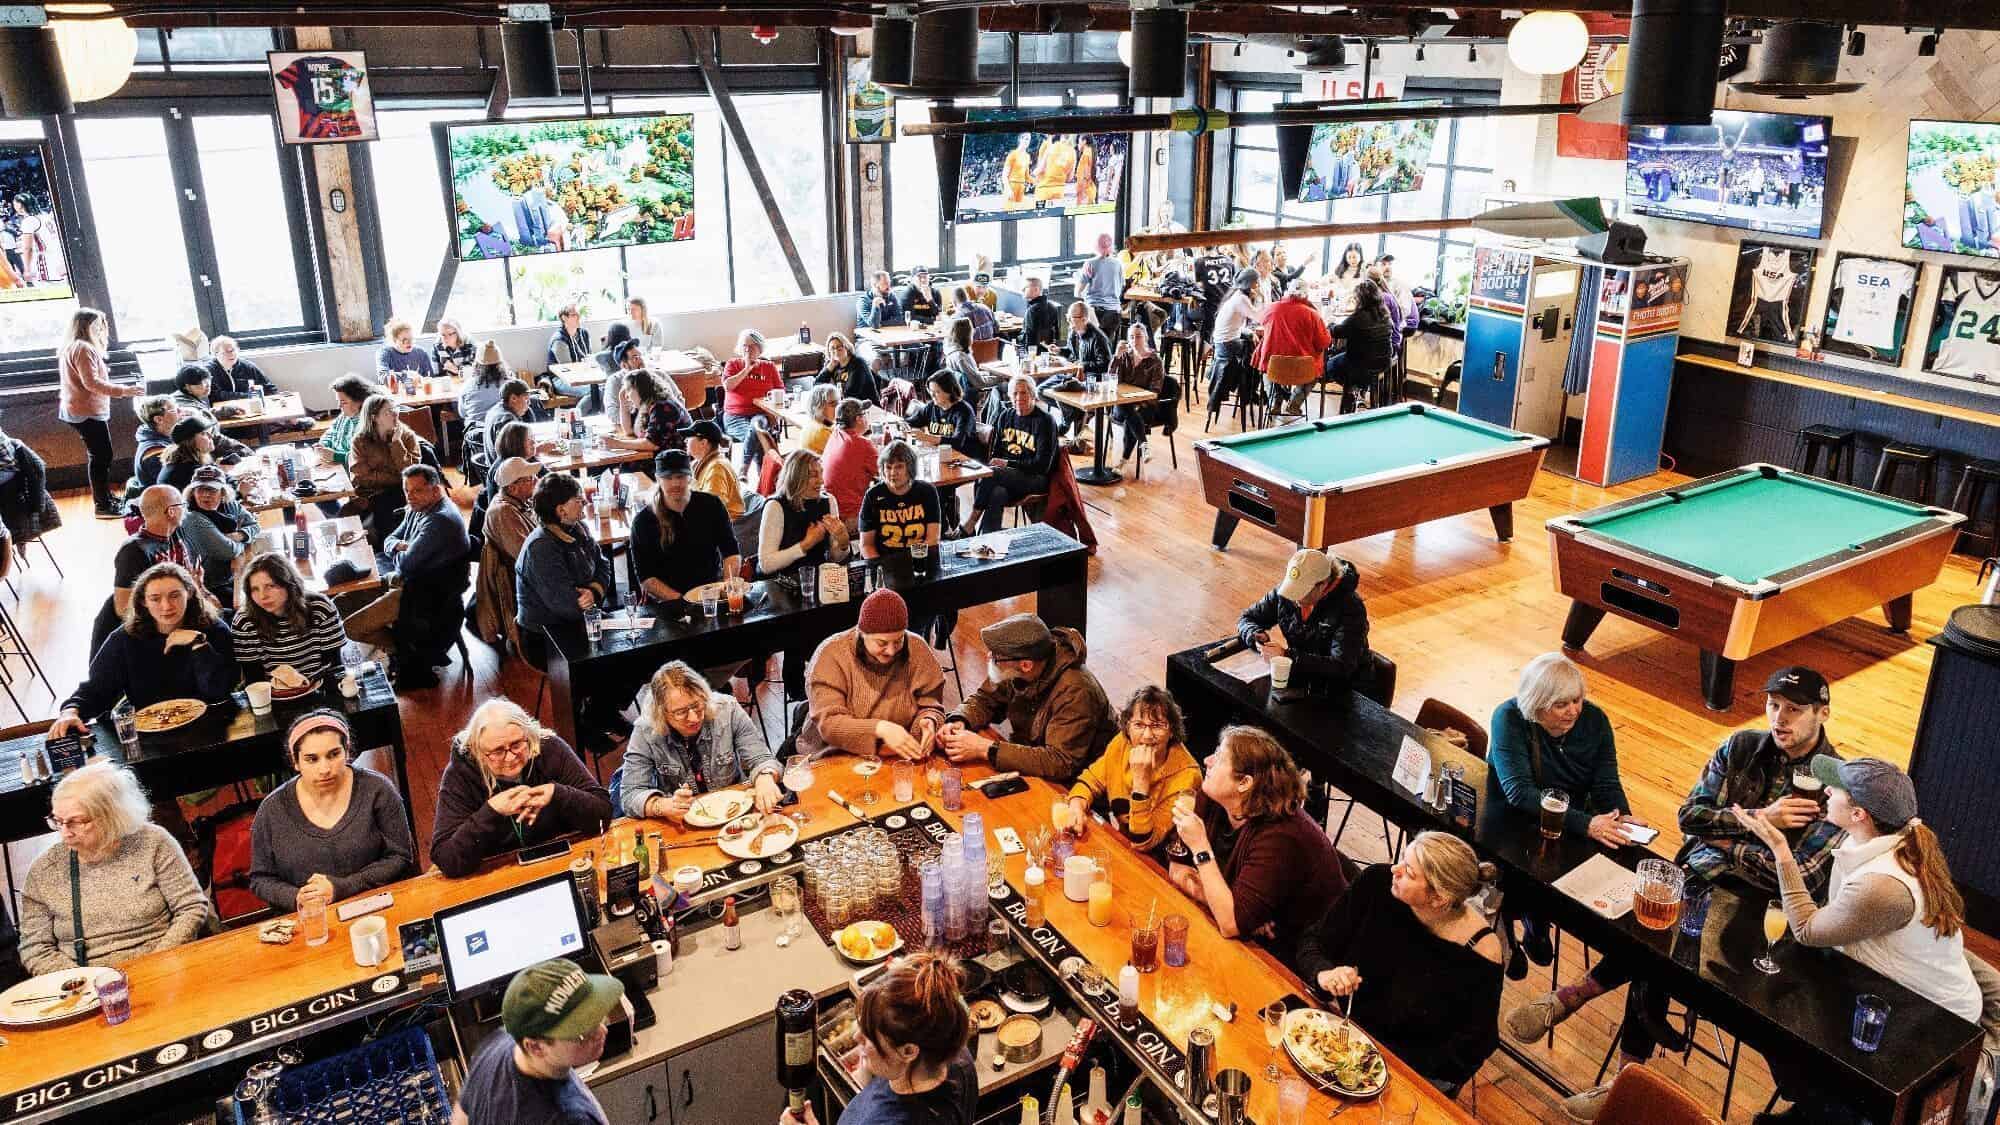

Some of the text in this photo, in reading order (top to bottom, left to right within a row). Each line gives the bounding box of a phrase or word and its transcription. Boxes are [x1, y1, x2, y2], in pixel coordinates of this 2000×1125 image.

[310, 77, 336, 104] 15
[1322, 79, 1385, 98] USA
[1207, 268, 1230, 285] 32
[1479, 275, 1521, 290] BOOTH
[1762, 269, 1785, 280] USA
[1857, 274, 1891, 288] SEA
[1955, 310, 2000, 345] 24
[1002, 427, 1036, 452] IOWA
[880, 503, 925, 523] IOWA
[881, 523, 925, 548] 22
[250, 1007, 299, 1035] BIG
[15, 1081, 72, 1113] BIG
